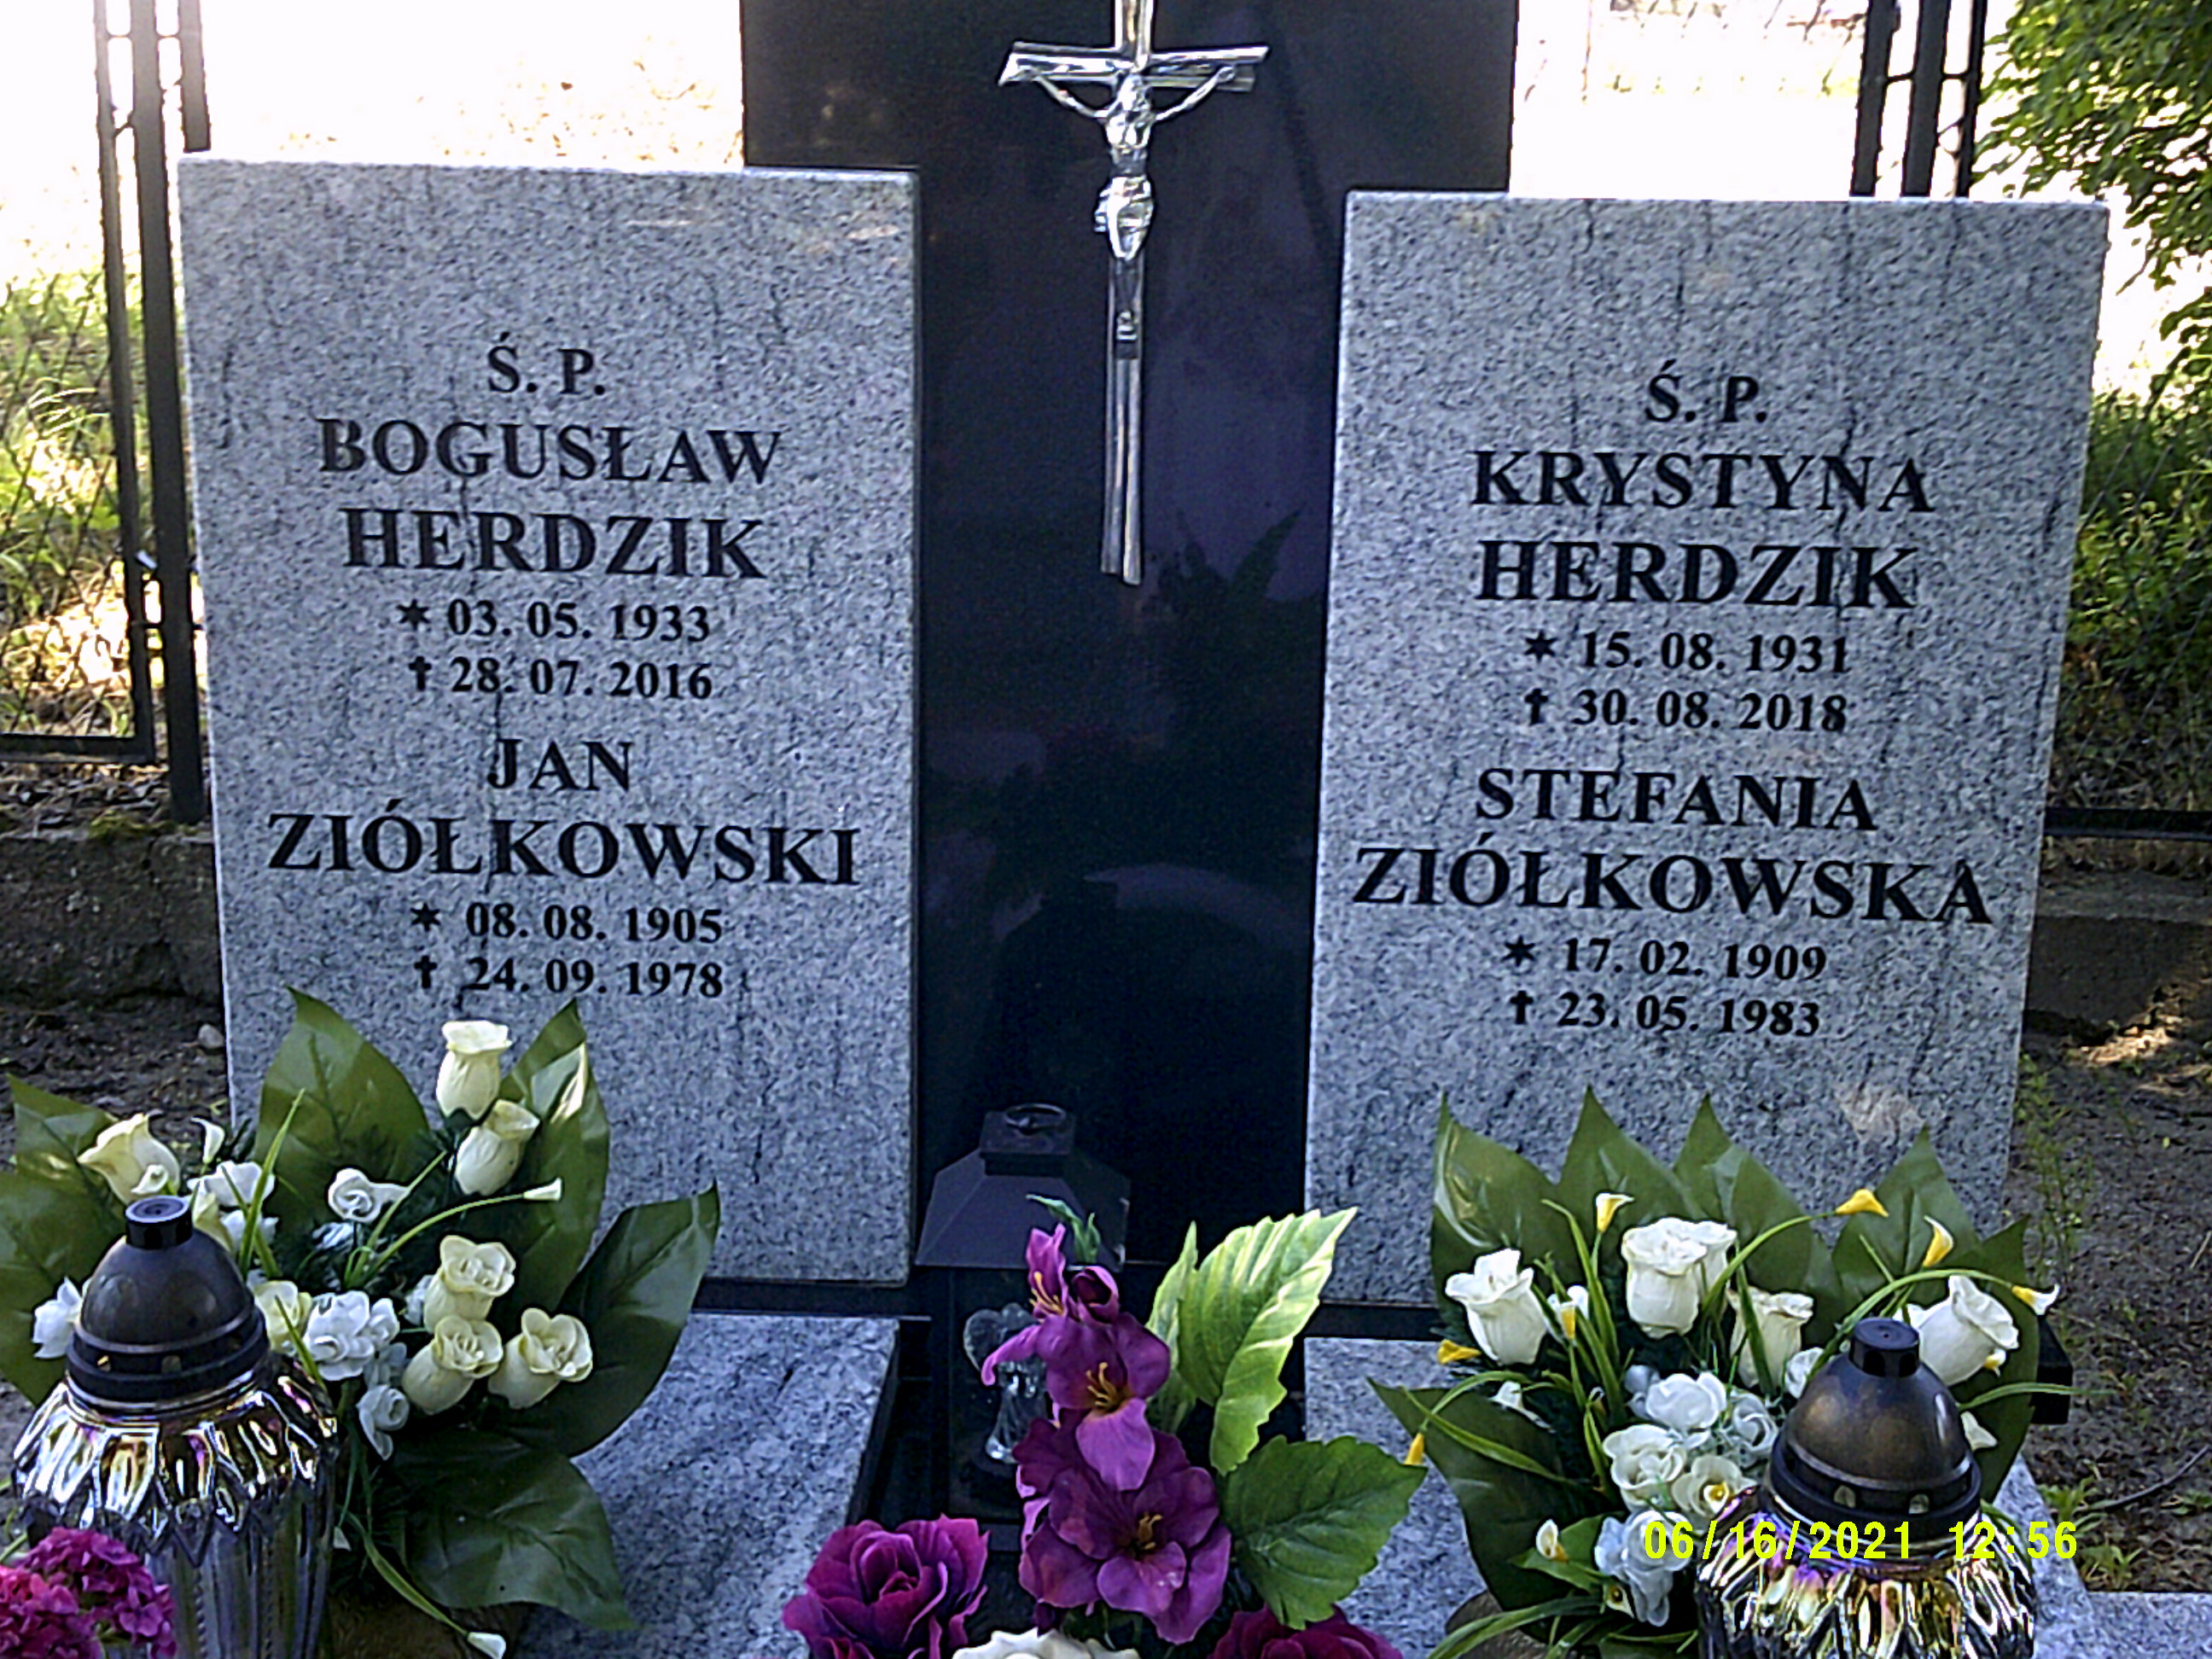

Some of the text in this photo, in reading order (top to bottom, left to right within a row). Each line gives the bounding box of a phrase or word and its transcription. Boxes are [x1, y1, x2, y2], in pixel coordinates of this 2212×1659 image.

[316, 418, 782, 484] BOGUSŁAW
[1471, 451, 1936, 512] KRYSTYNA
[341, 508, 768, 579] HERDZIK
[1476, 539, 1919, 609] HERDZIK
[487, 738, 634, 792] JAN
[1476, 768, 1877, 831] STEFANIA
[268, 799, 861, 885] ZIÓŁKOWSKI
[1353, 832, 1994, 924] ZIÓŁKOWSKA
